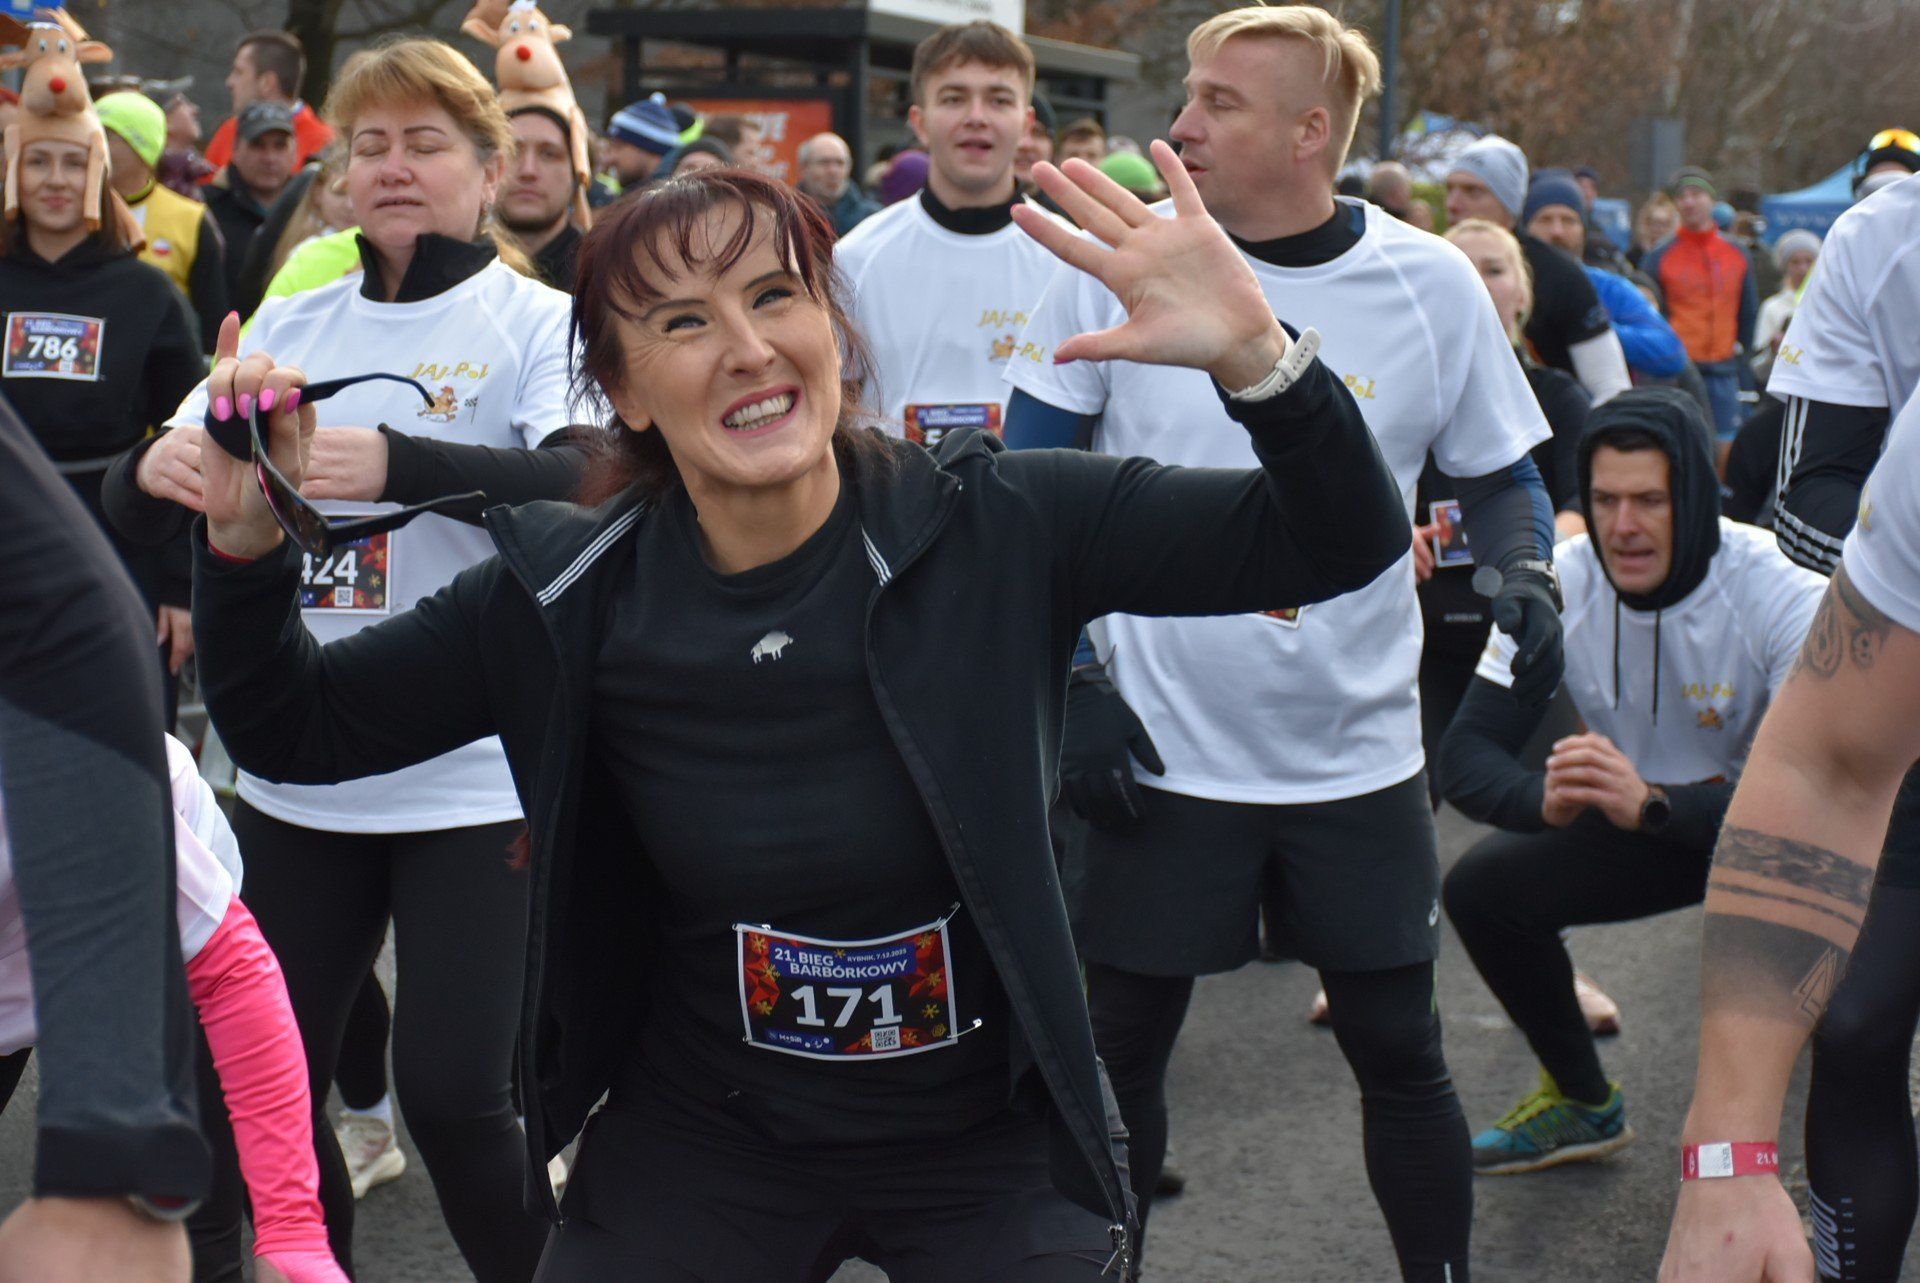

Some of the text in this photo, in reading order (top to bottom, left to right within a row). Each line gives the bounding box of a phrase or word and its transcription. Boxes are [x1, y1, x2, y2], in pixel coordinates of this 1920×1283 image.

[28, 335, 79, 360] 786
[301, 550, 358, 585] 424
[774, 948, 834, 967] 21. BIEG
[847, 954, 876, 964] RYBNIK,
[790, 959, 908, 979] BARBÓRKOWY
[790, 984, 903, 1028] 171
